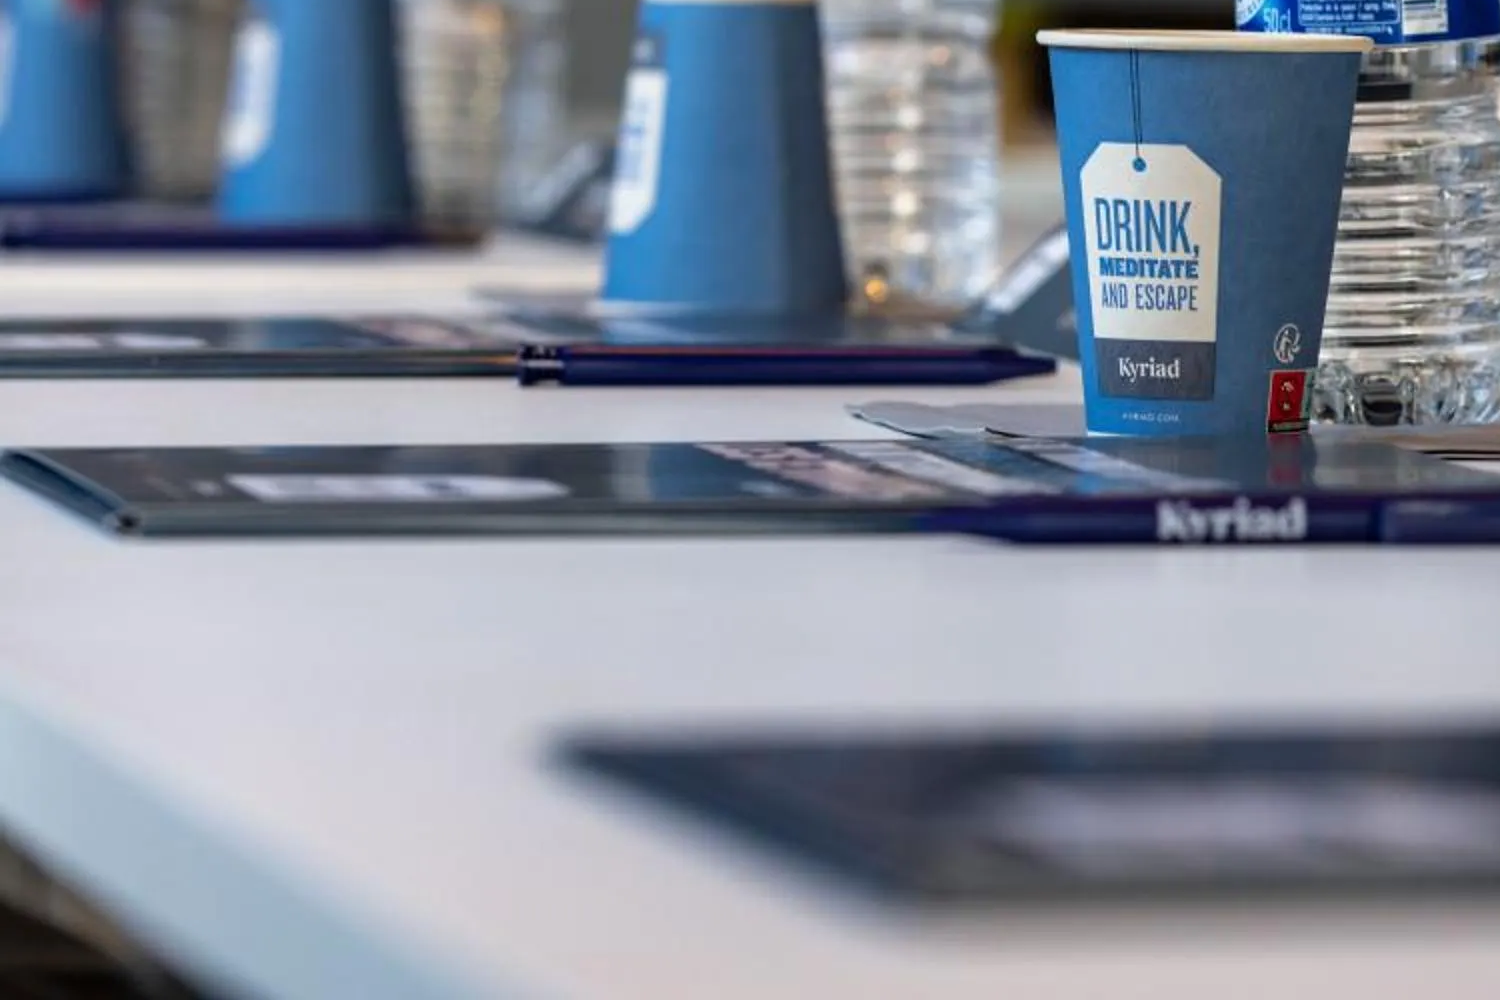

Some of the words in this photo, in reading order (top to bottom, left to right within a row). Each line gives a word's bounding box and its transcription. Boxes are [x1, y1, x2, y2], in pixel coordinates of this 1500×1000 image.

[1094, 197, 1200, 259] DRINK,
[1098, 257, 1200, 280] MEDITATE
[1102, 281, 1129, 310] AND
[1135, 283, 1199, 312] ESCAPE
[1118, 357, 1181, 382] Kyriad
[1156, 497, 1306, 542] Kyriad
